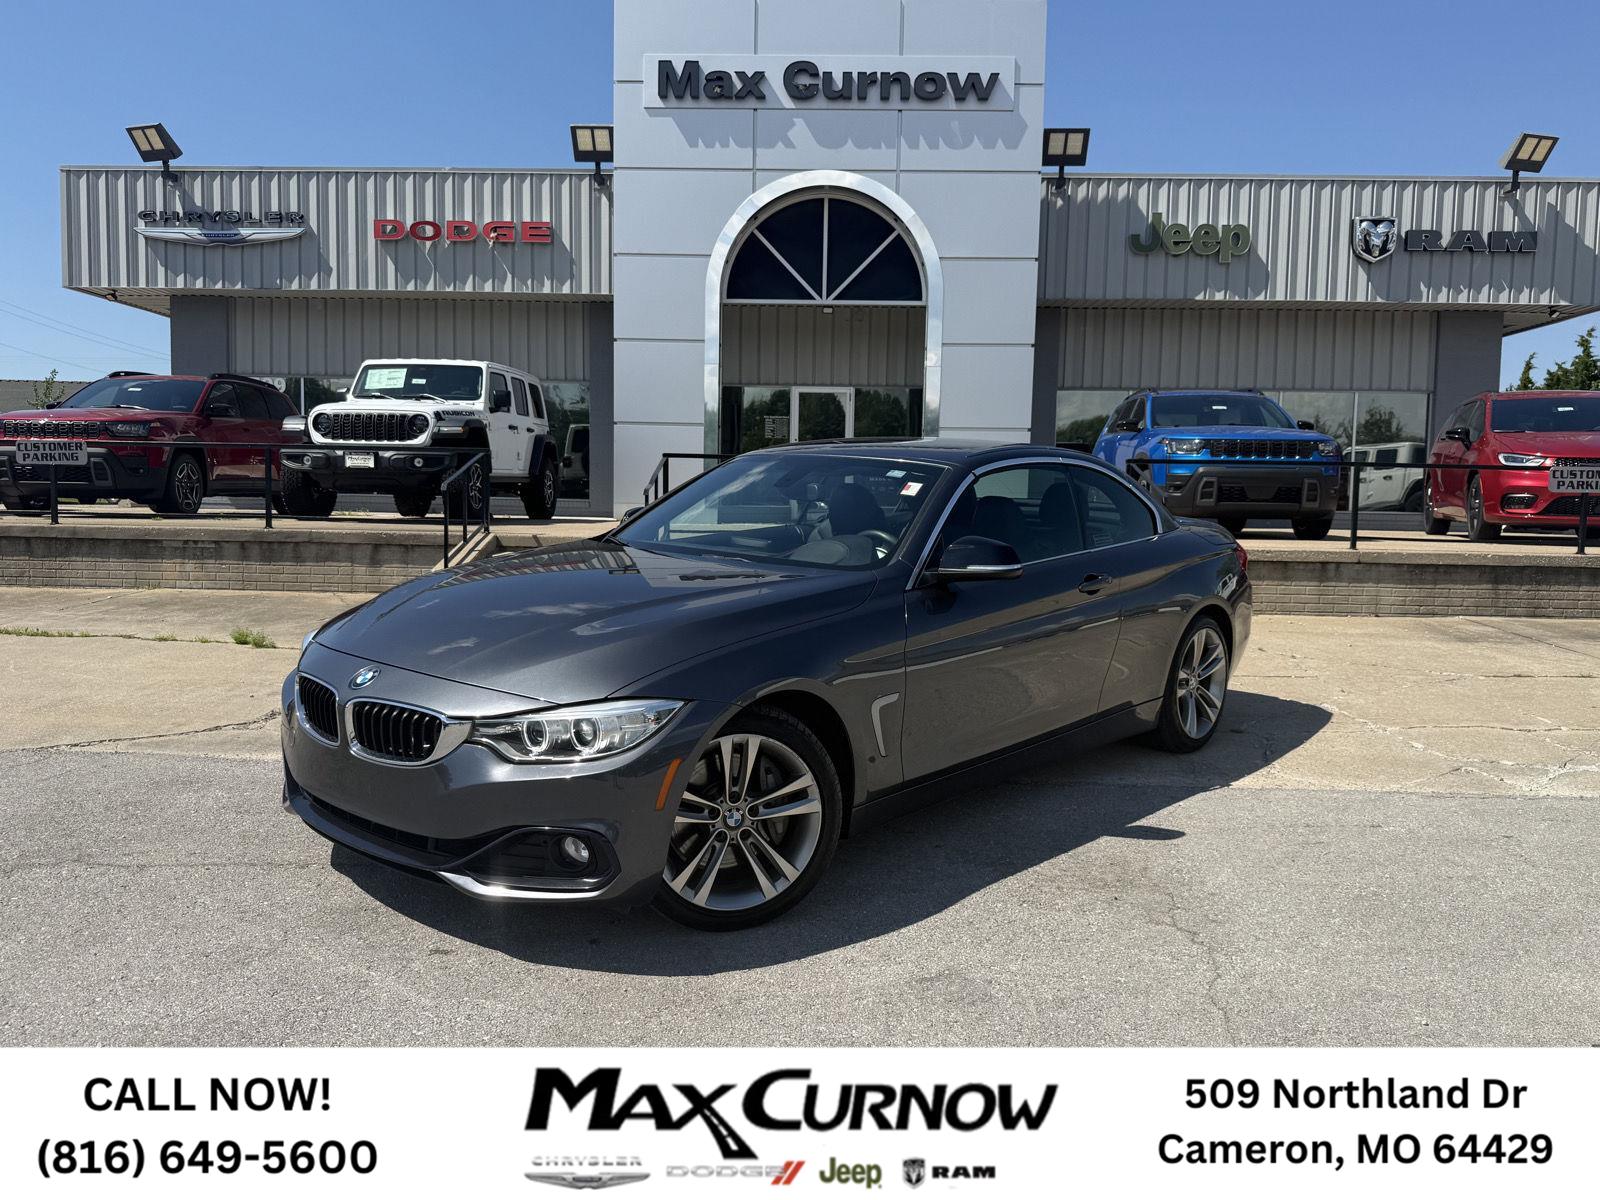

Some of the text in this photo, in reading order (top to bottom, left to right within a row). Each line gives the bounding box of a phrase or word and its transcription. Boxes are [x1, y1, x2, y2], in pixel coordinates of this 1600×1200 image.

[657, 60, 1000, 102] Max Curnow
[137, 210, 305, 224] CHRYSLER
[373, 219, 553, 243] DODGE
[1128, 212, 1252, 265] Jeep
[1404, 229, 1538, 253] RAM
[17, 442, 83, 452] CUSTOMER
[22, 452, 79, 462] PARKING
